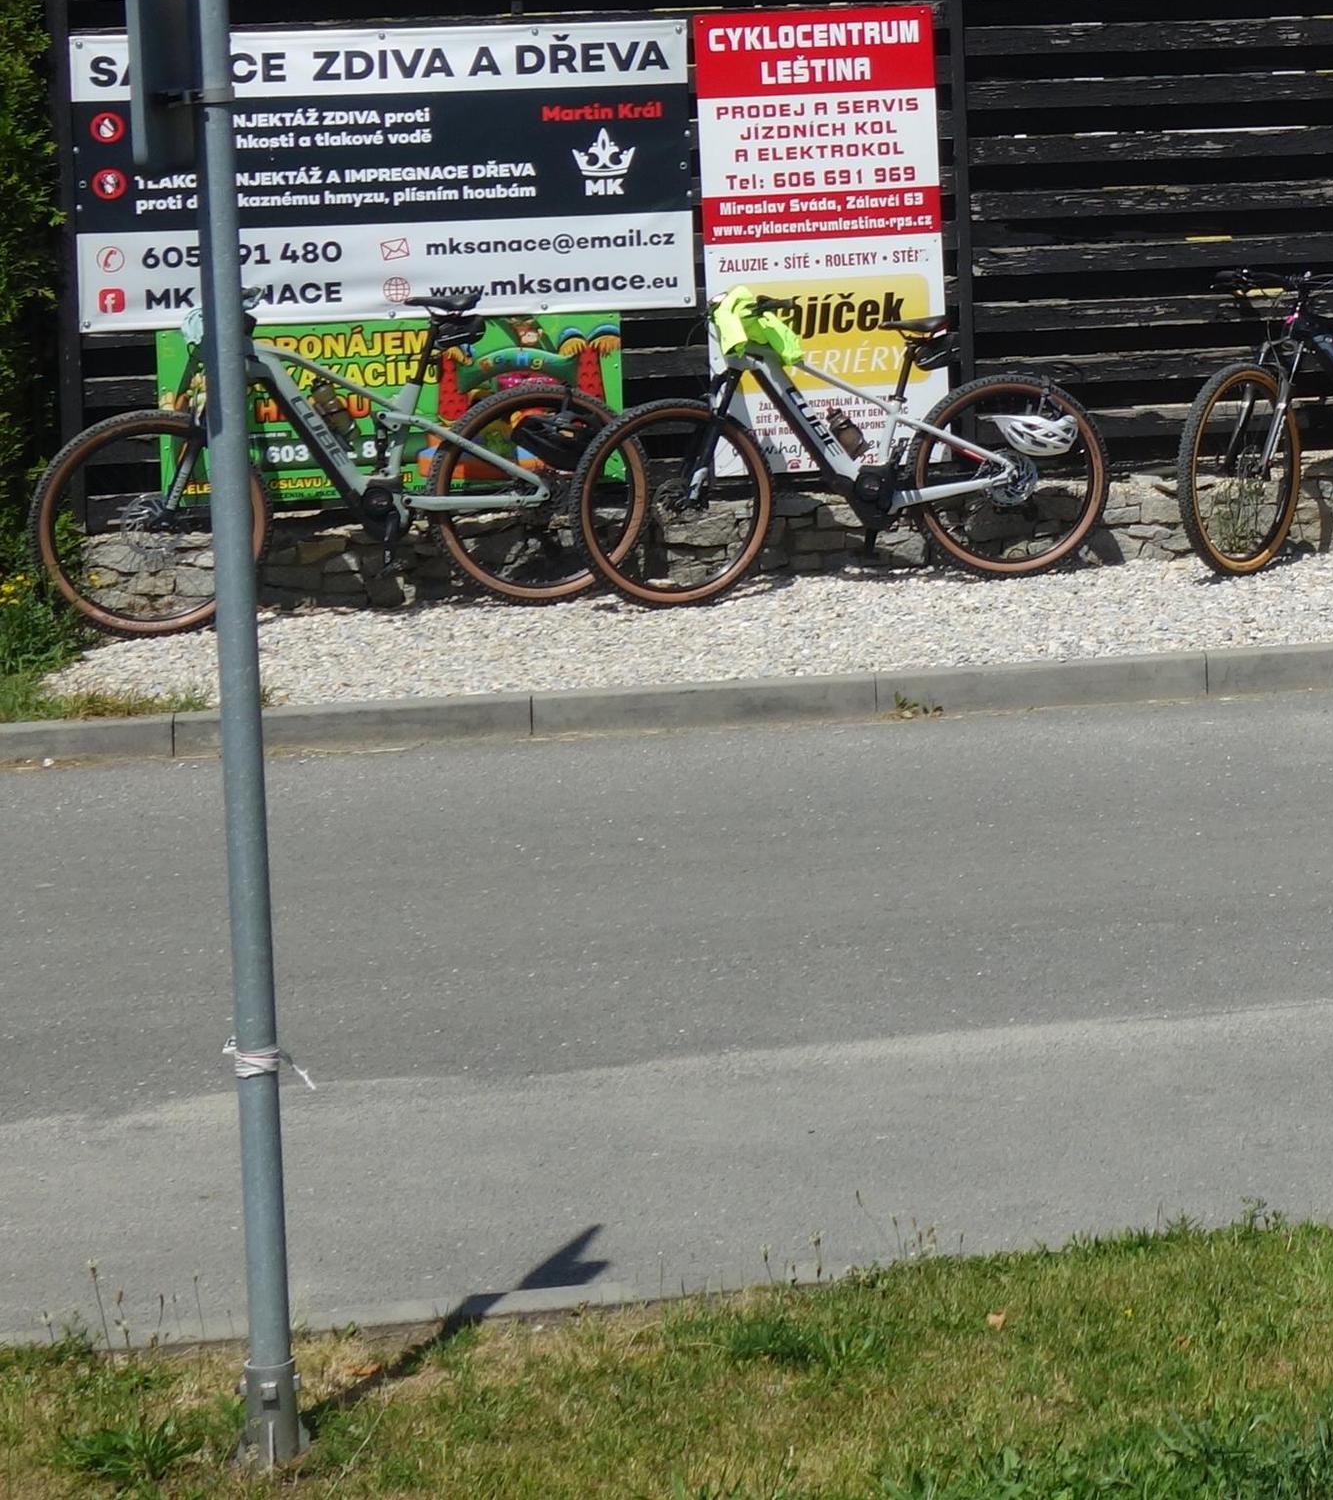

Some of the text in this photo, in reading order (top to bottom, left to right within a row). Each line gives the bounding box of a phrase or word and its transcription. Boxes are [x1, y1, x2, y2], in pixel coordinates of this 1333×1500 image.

[707, 20, 920, 52] CYKLOCENTRUM
[89, 34, 670, 87] SCE ZDIVA A DŘEVA
[761, 55, 871, 85] LEŠTINA
[233, 107, 430, 128] NJEKTÁŽ ZDIVA proti
[542, 101, 662, 122] Martin Král
[716, 98, 919, 120] PRODEJ A SERVIS
[236, 130, 432, 149] hkosti a tlakové vodě
[740, 120, 897, 140] JÍZDNÍCH KOL
[735, 142, 904, 162] A ELEKTROKOL
[236, 167, 322, 187] NJEKTÁŽ
[326, 169, 340, 184] A
[344, 164, 469, 183] IMPREGNACE
[473, 161, 536, 179] DŘEVA
[726, 166, 916, 190] Tel: 606 691 969
[136, 194, 182, 214] proti
[324, 190, 390, 209] hmyzu,
[394, 186, 459, 206] plísním
[463, 183, 537, 201] houbám
[585, 178, 624, 196] MK
[719, 192, 923, 215] Miroslav Sváda, Zálavčí 63
[425, 229, 675, 256] mksanace@email.cz
[142, 241, 342, 269] 605 91 480
[719, 256, 768, 274] ŽALUZIE
[784, 256, 809, 270] SÍTĚ
[826, 252, 877, 268] ROLETKY
[429, 274, 678, 298] www.mksanace.eu
[145, 287, 196, 310] MK
[781, 292, 904, 339] ájíček
[266, 444, 309, 463] 603
